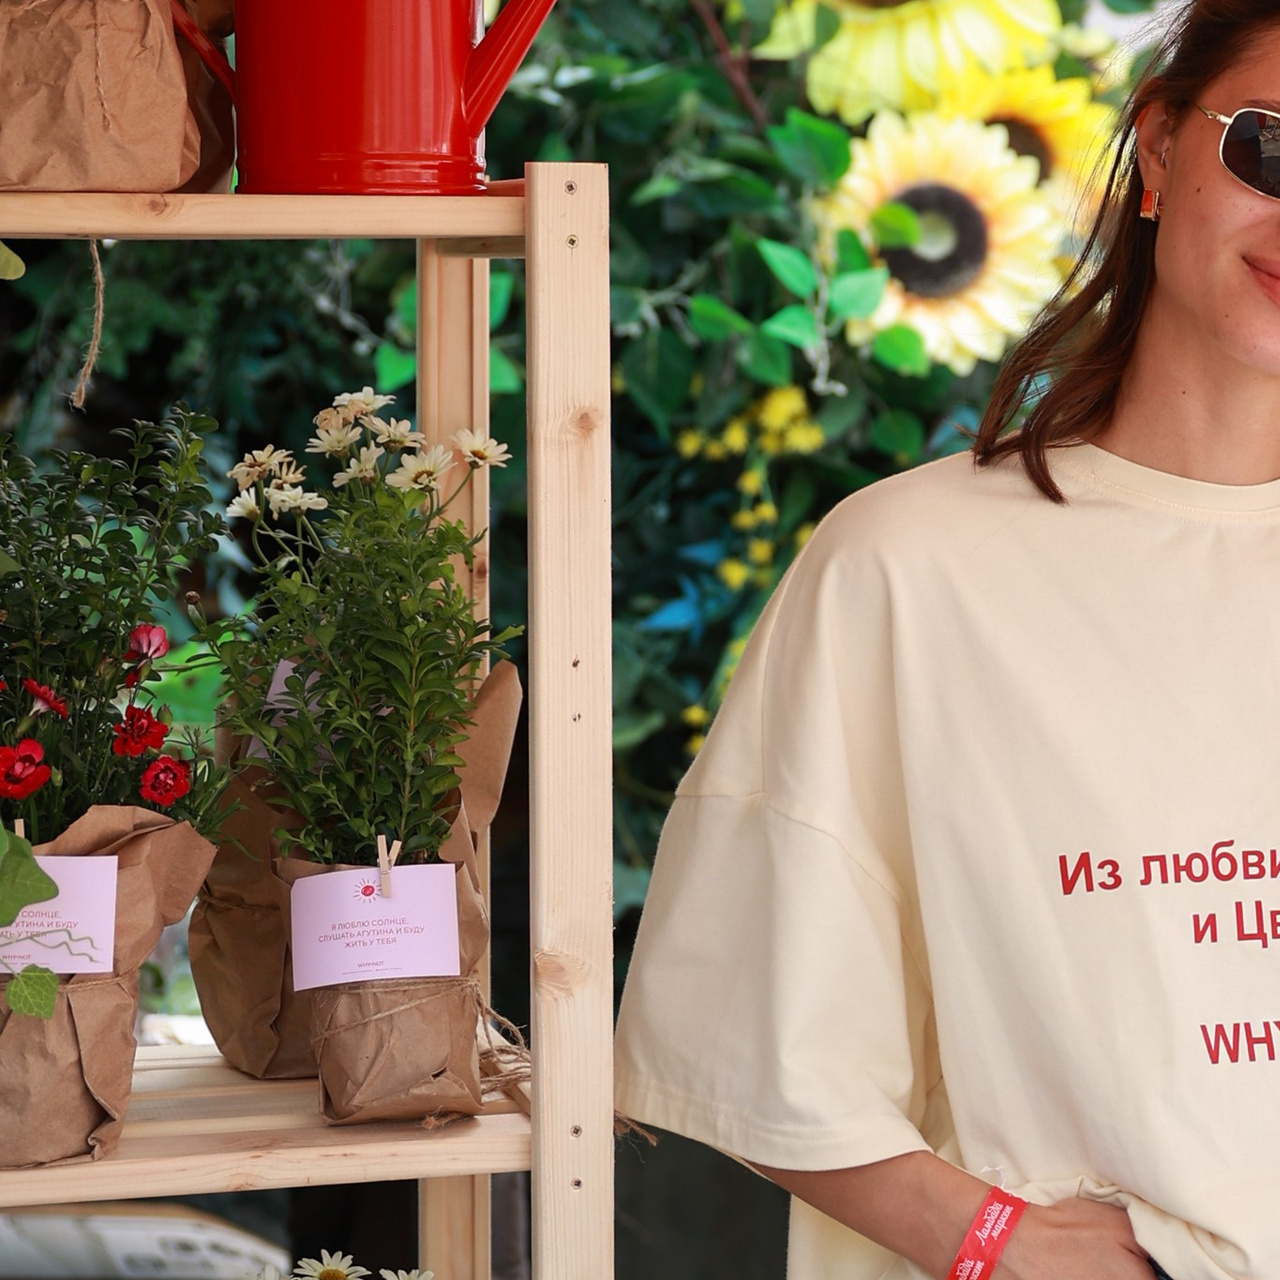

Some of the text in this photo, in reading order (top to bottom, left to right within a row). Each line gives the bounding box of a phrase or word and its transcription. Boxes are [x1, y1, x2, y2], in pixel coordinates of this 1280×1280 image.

[1058, 851, 1123, 895] Из
[55, 921, 79, 929] БУДУ
[318, 925, 425, 943] СЛУШАТЬ АГУТИНА И БУДУ
[337, 920, 370, 931] ЛЮБЛЮ
[1192, 913, 1217, 944] и
[344, 939, 368, 949] ЖИТЬ
[376, 937, 397, 946] ТЕБЯ
[975, 1201, 1003, 1247] Ламбада
[990, 1204, 1014, 1240] маркет
